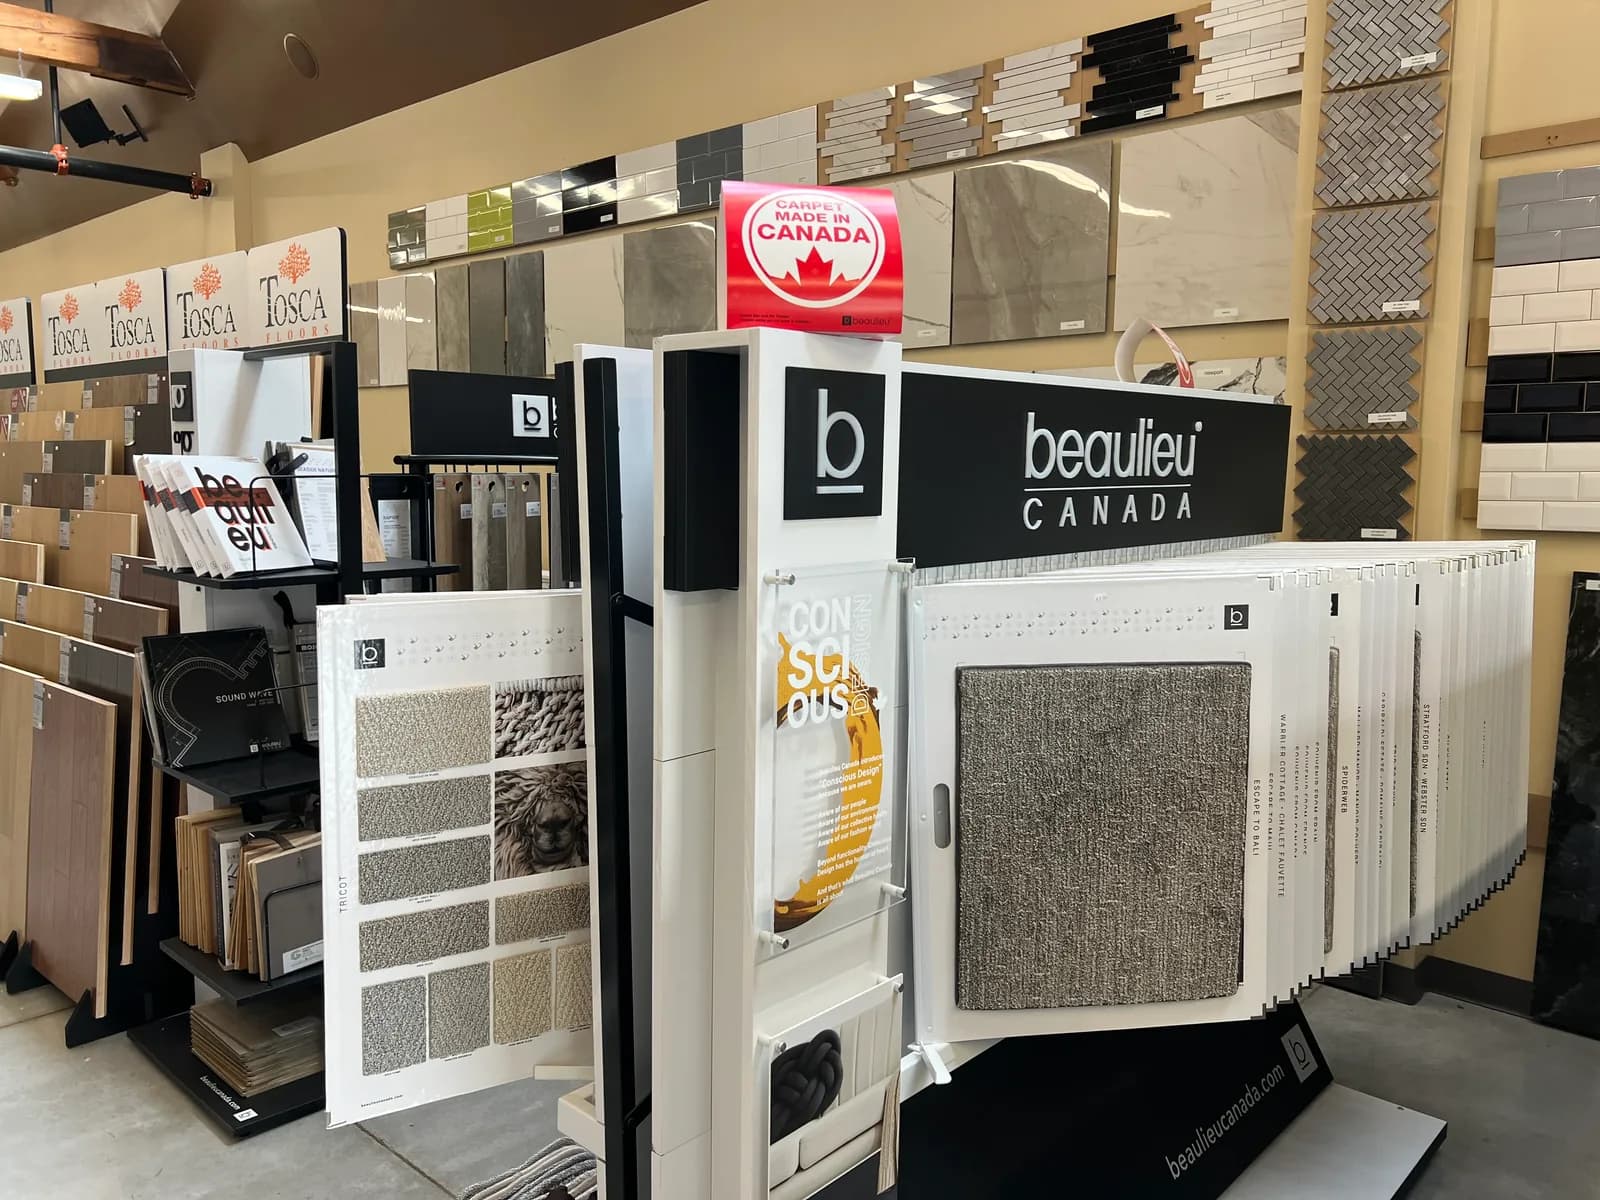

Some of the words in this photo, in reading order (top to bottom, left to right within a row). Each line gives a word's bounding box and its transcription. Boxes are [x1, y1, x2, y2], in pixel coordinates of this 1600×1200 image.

[775, 211, 828, 223] MADE
[834, 214, 850, 223] IN
[776, 200, 843, 211] CARPET
[757, 223, 871, 243] CANADA
[266, 324, 329, 344] FLOORS
[523, 401, 541, 425] b
[816, 388, 865, 479] b
[1024, 412, 1198, 479] beaulieu
[1022, 492, 1191, 530] CANADA
[789, 596, 851, 638] CON
[1230, 608, 1243, 623] b
[362, 643, 378, 661] b
[788, 634, 850, 689] SCI
[216, 693, 246, 704] SOUND
[787, 683, 849, 729] OUS
[1279, 713, 1287, 759] WARBLER
[1253, 779, 1261, 815] ESCAPE
[1341, 765, 1349, 813] SPIDERWEB
[1420, 778, 1428, 814] WEBSTER
[1253, 819, 1260, 831] TO
[1278, 813, 1286, 848] CHALET
[1252, 835, 1260, 856] BALI
[817, 865, 835, 877] Design
[835, 863, 845, 871] has
[1277, 852, 1285, 898] FAUVETTE
[339, 875, 348, 913] TRICOT
[817, 888, 828, 897] And
[1165, 1064, 1285, 1180] beaulieucanada.com
